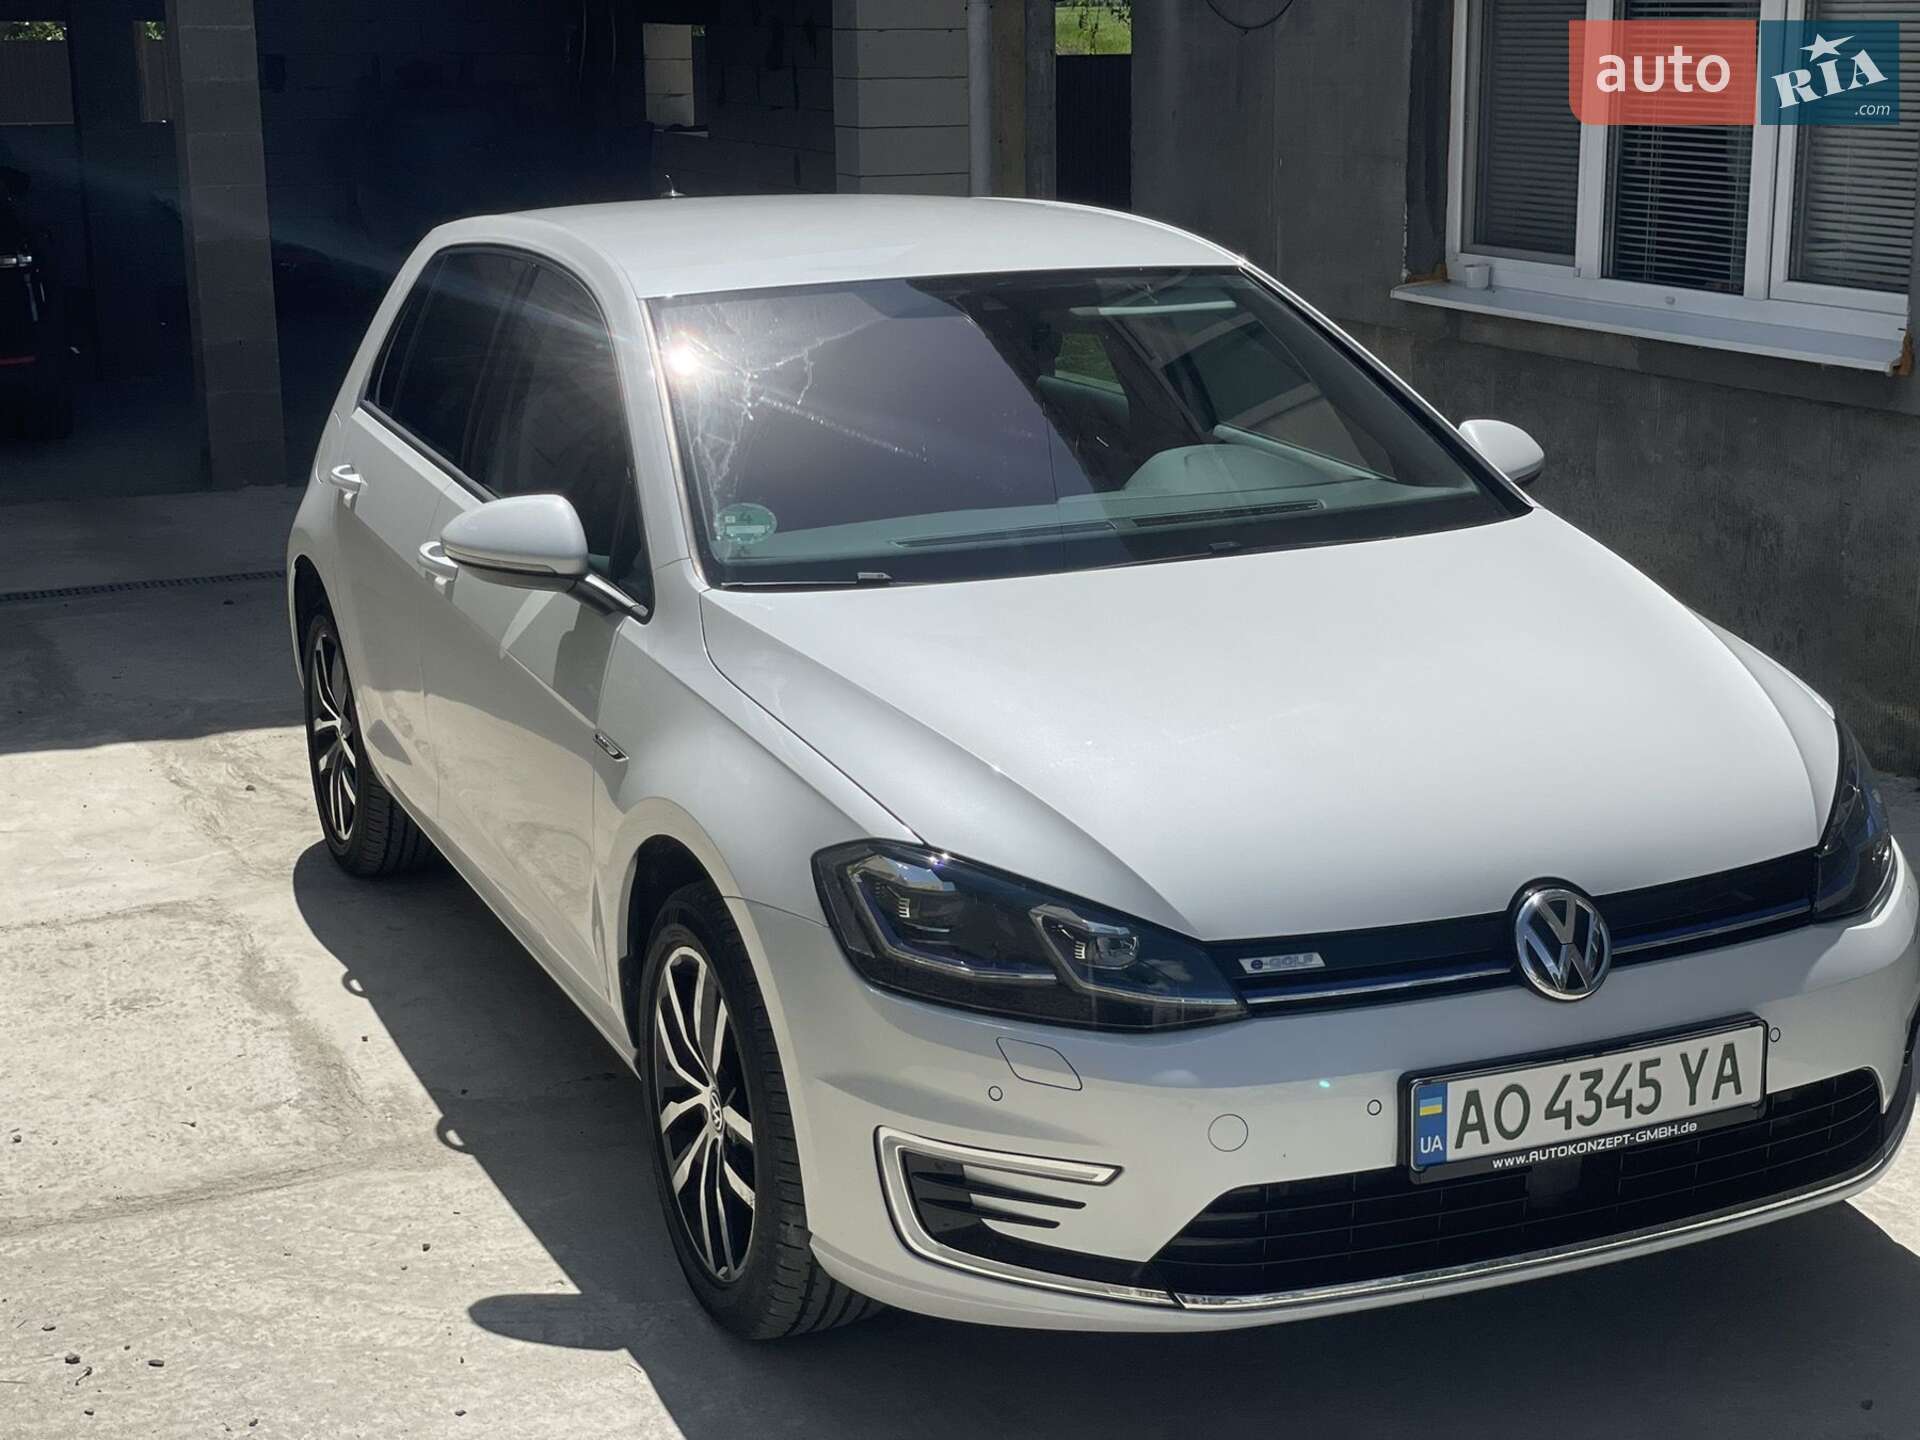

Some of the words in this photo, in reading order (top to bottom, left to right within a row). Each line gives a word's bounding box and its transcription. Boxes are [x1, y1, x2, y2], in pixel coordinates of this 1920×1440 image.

[1455, 1084, 1530, 1149] AO
[1544, 1058, 1662, 1130] 4345
[1680, 1043, 1742, 1106] YA
[1420, 1135, 1443, 1154] UA
[1492, 1122, 1697, 1169] www.AUTOKONZEPT-GMBH.de
